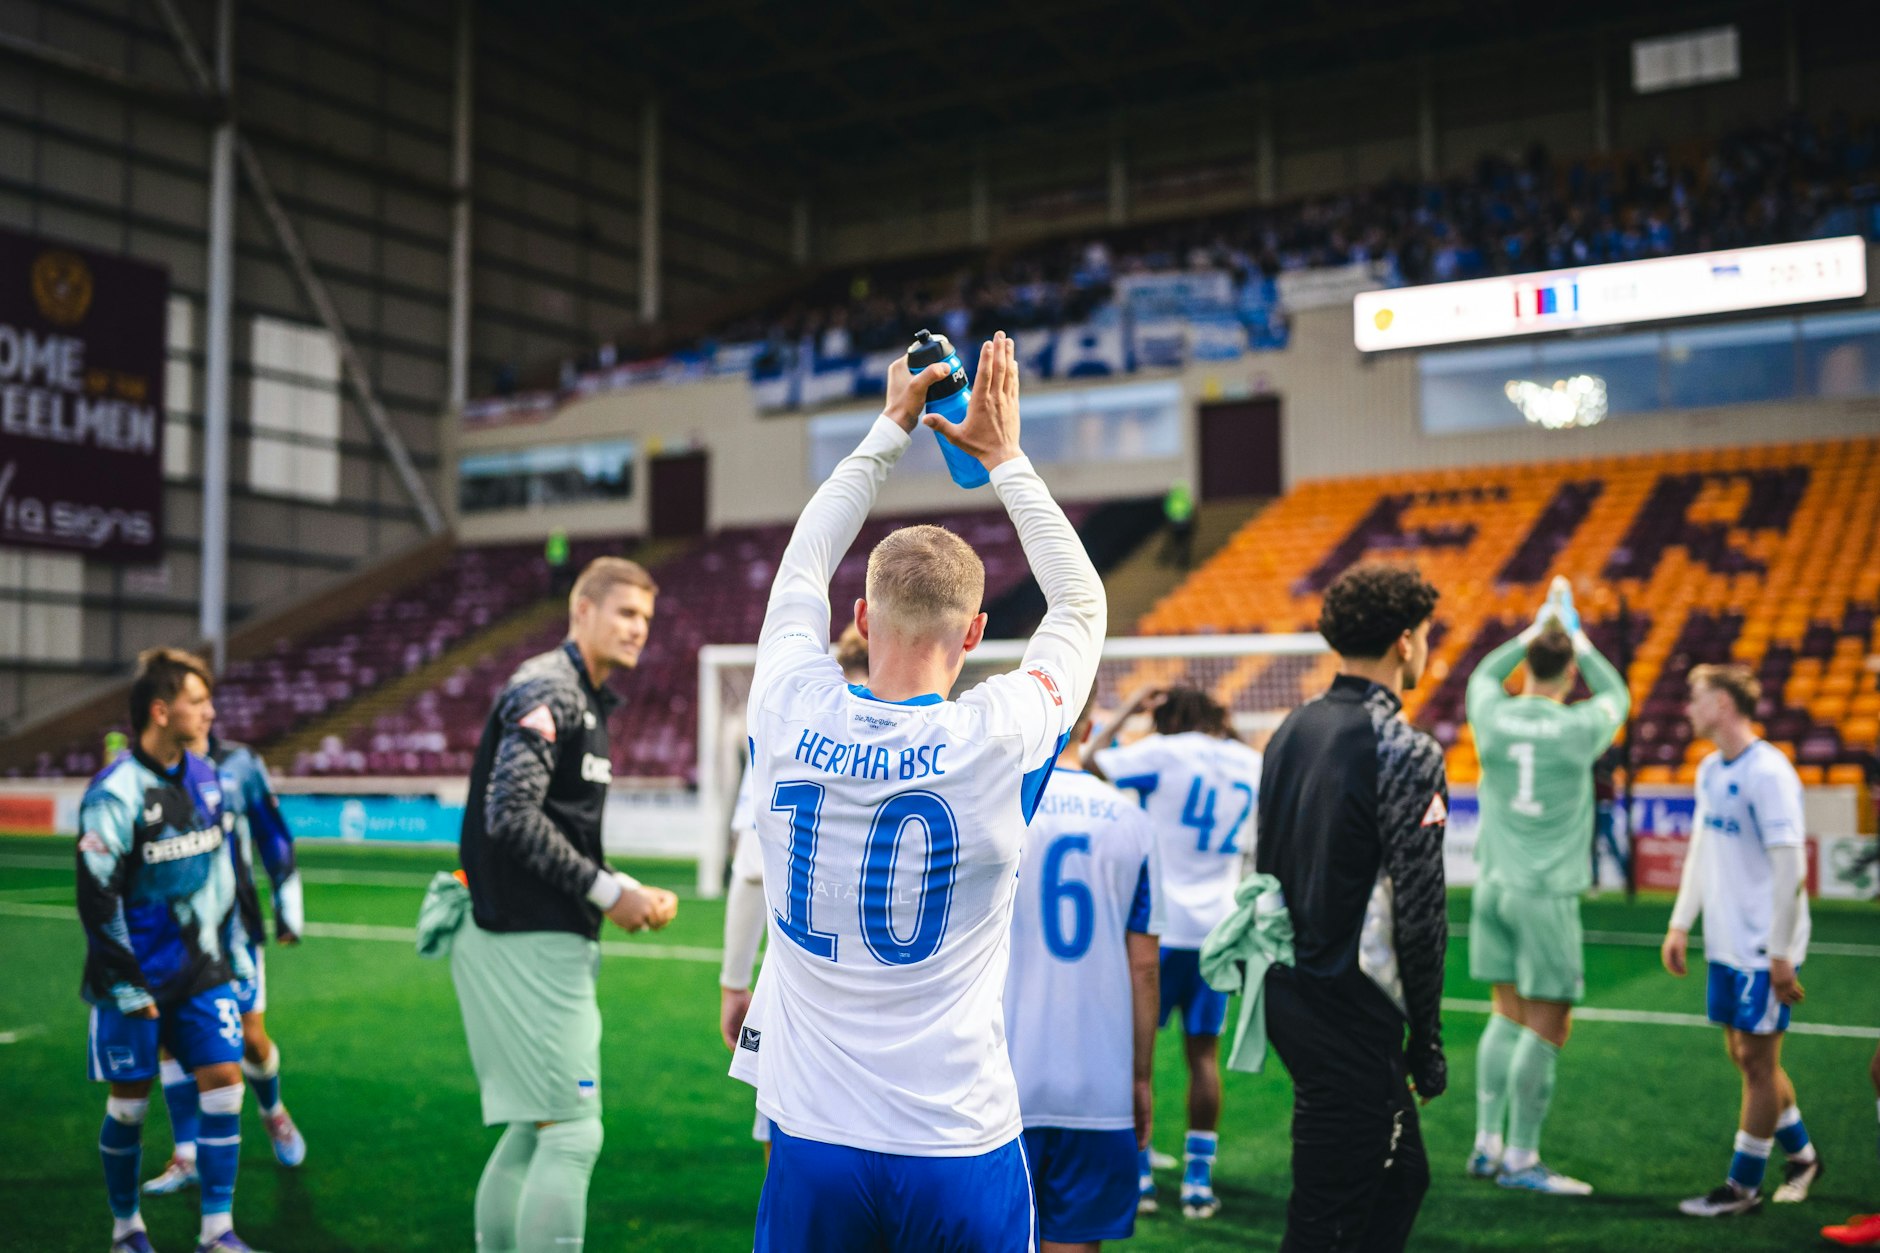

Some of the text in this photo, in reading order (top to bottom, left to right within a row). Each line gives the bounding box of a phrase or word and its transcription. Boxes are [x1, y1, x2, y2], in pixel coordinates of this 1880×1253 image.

[0, 384, 156, 453] EELMEN
[795, 729, 946, 780] HERTHA BSC
[1508, 742, 1543, 816] 1
[1181, 775, 1253, 853] 42
[771, 780, 960, 966] 10
[1041, 833, 1095, 960] 6
